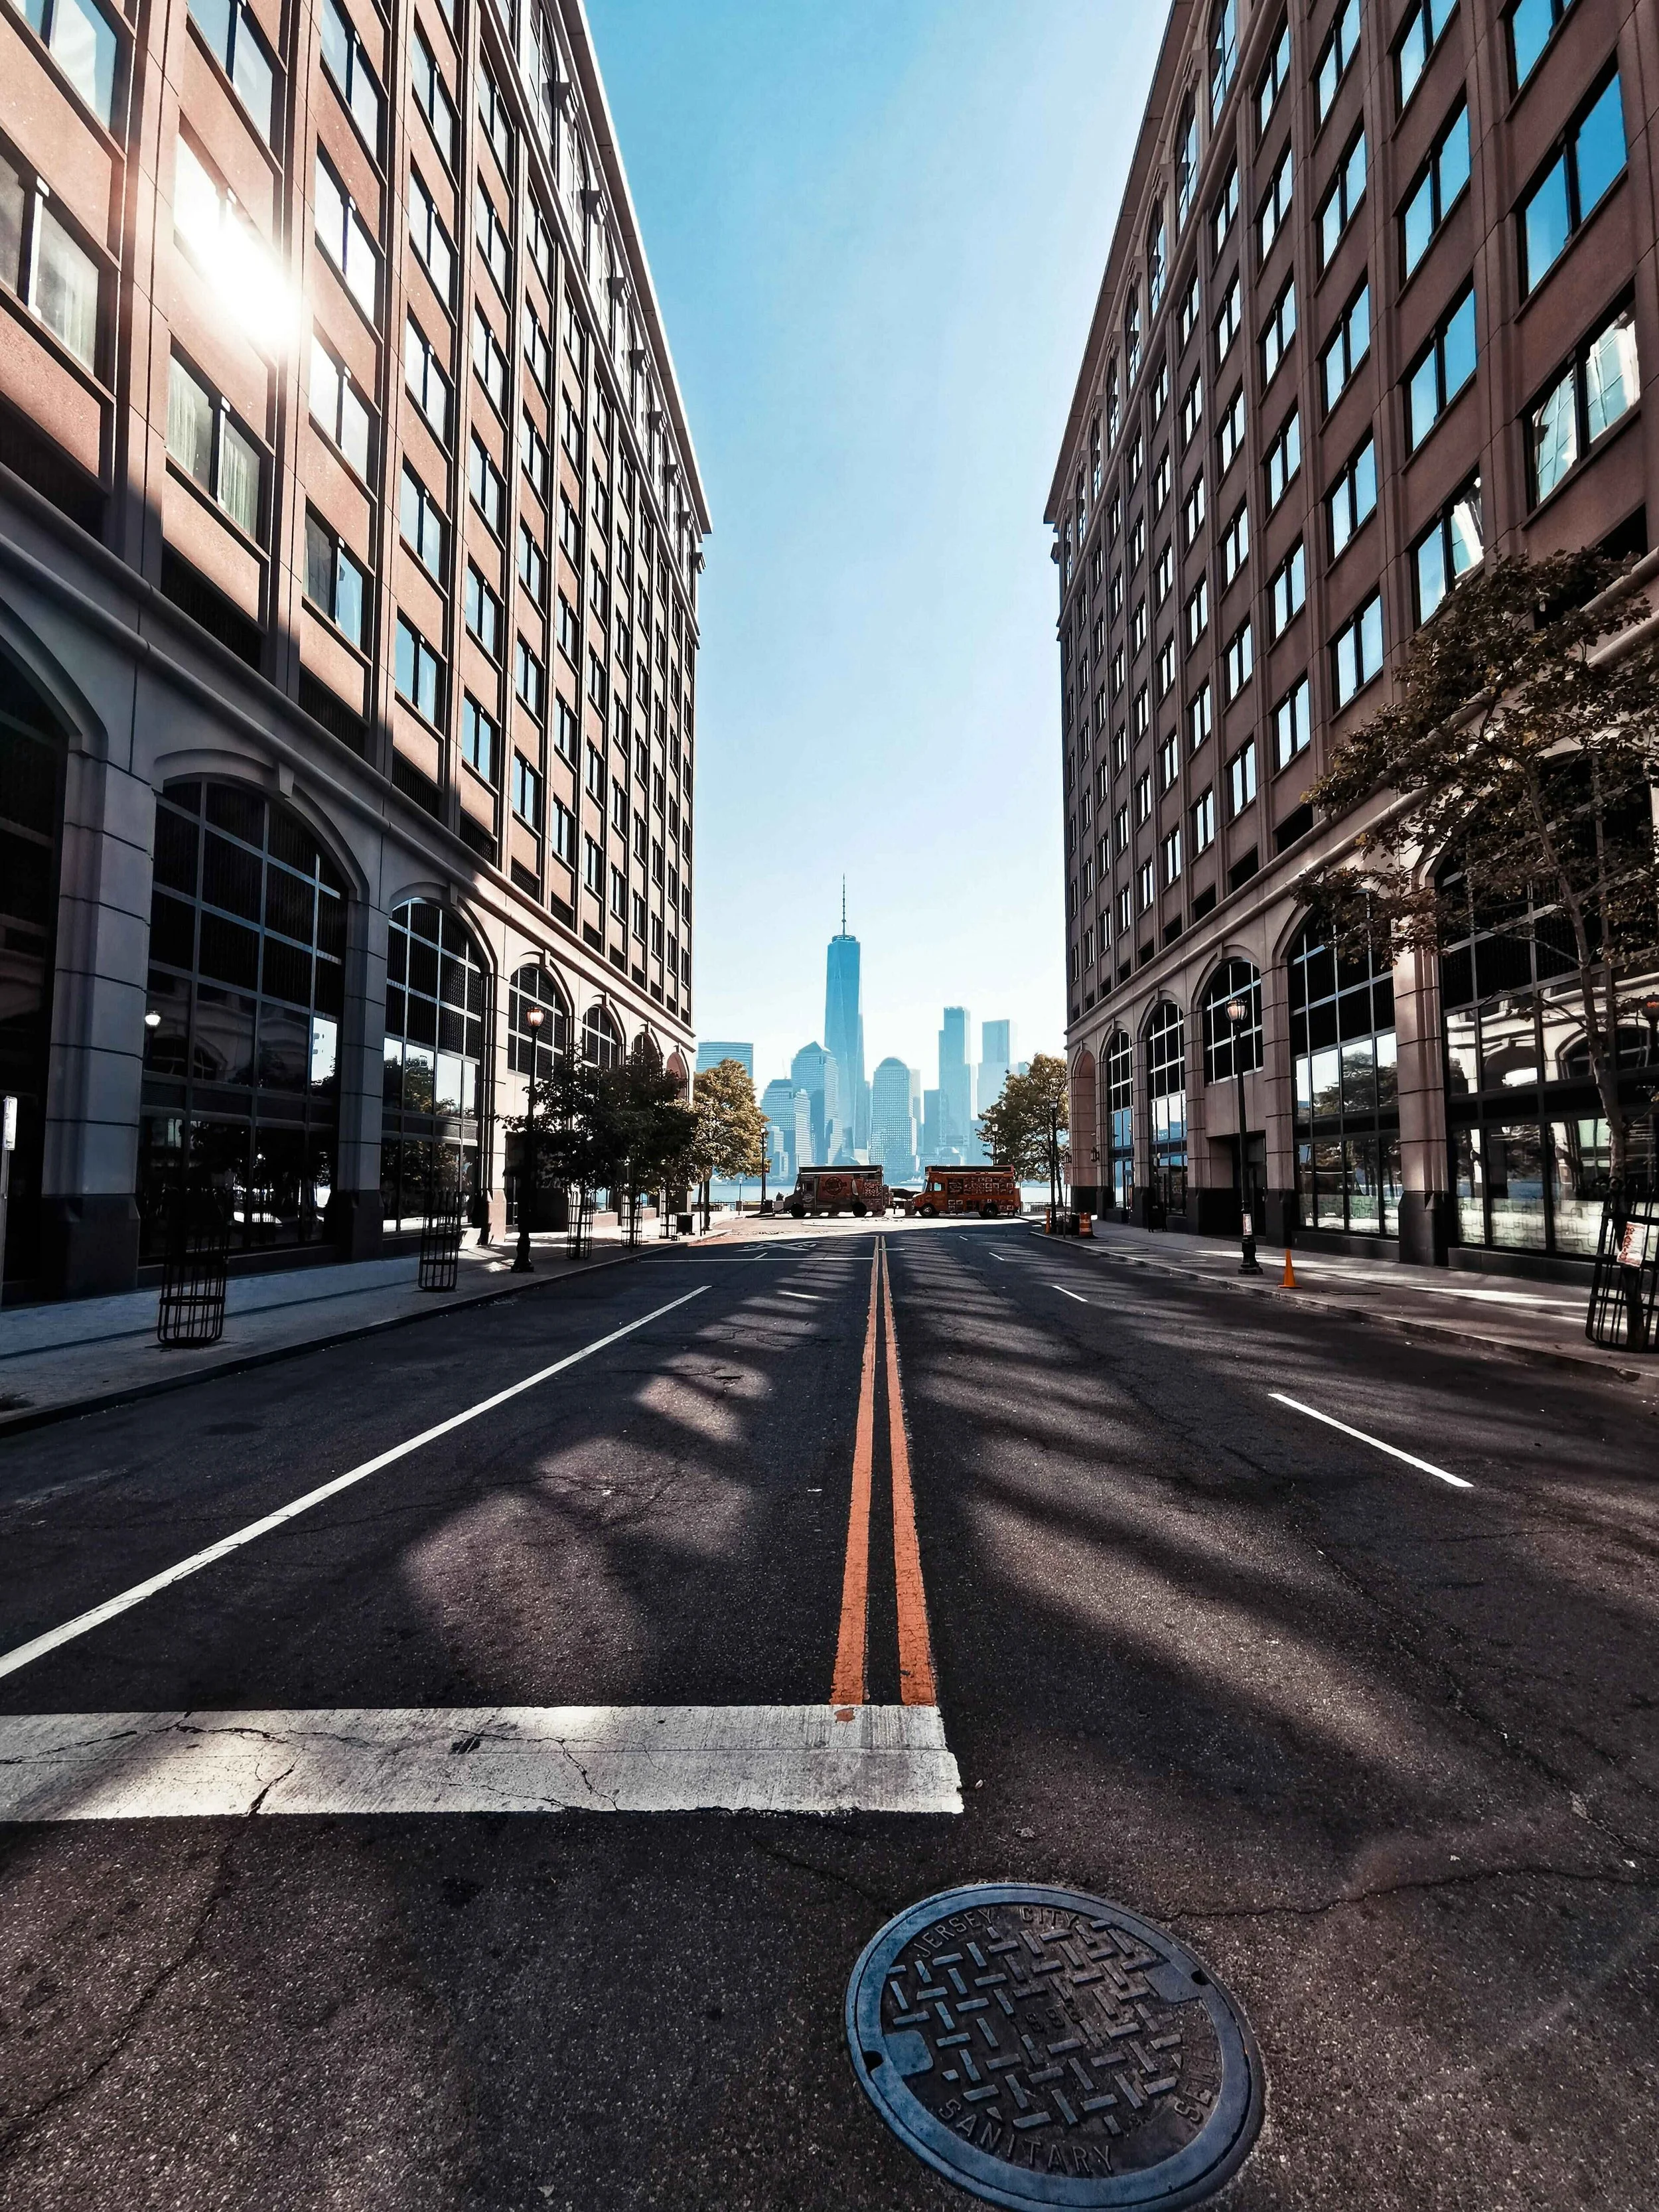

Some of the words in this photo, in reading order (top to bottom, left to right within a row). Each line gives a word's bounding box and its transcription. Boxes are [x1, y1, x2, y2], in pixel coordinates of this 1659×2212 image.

[913, 1908, 993, 1958] JERSEY
[1020, 1907, 1080, 1928] CITY
[938, 2098, 1114, 2174] SANITARY
